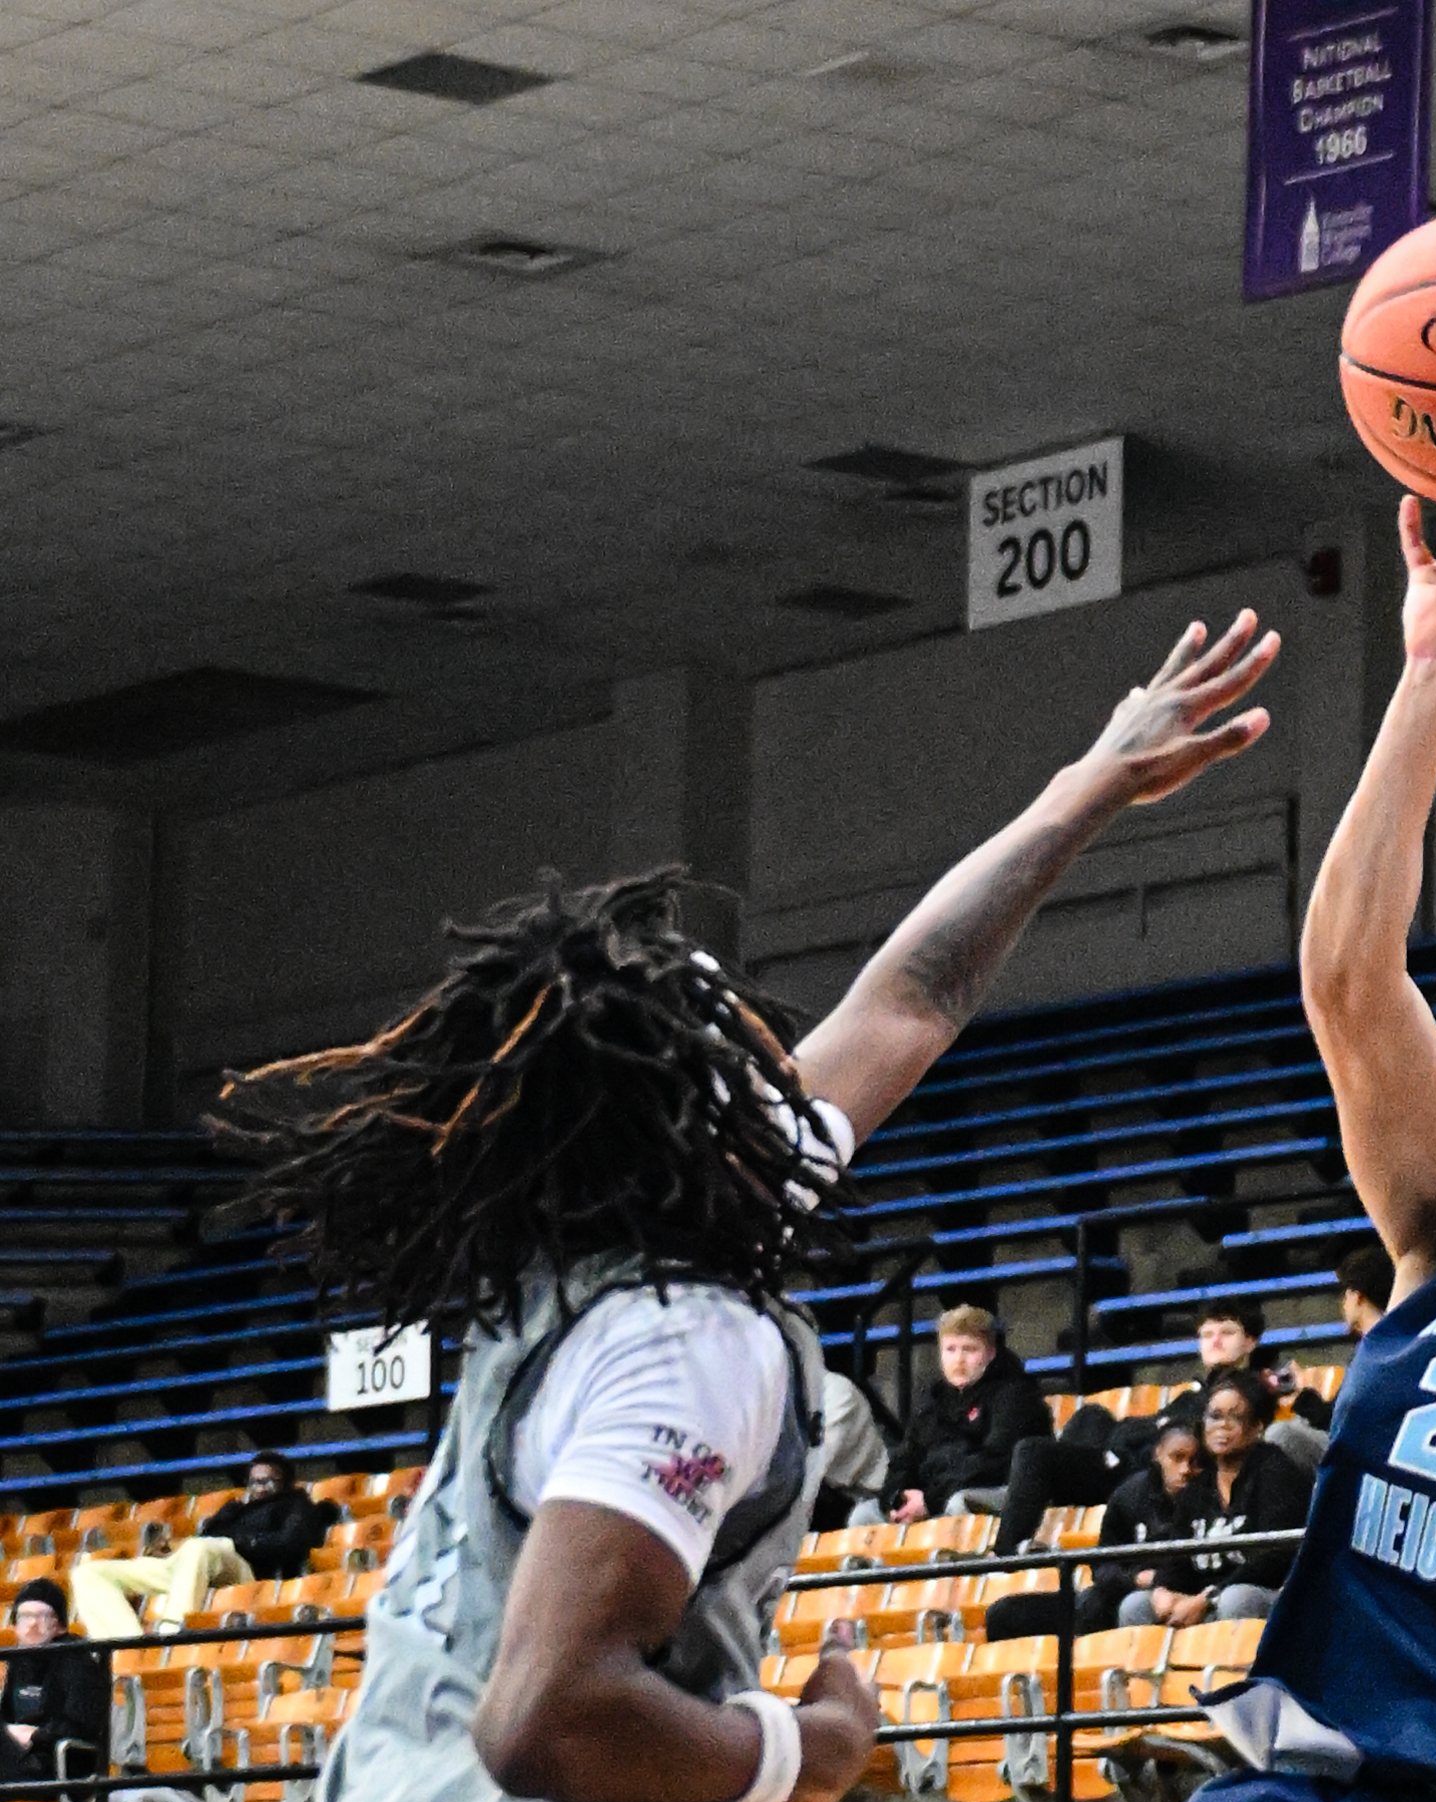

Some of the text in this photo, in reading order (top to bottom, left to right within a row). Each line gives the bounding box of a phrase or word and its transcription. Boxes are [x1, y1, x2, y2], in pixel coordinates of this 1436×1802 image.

[1303, 31, 1383, 69] NATIONAL
[1298, 93, 1384, 134] CHAMPION
[1315, 125, 1368, 165] 1966
[982, 460, 1109, 528] SECTION
[996, 519, 1091, 598] 200
[357, 1355, 405, 1395] 100
